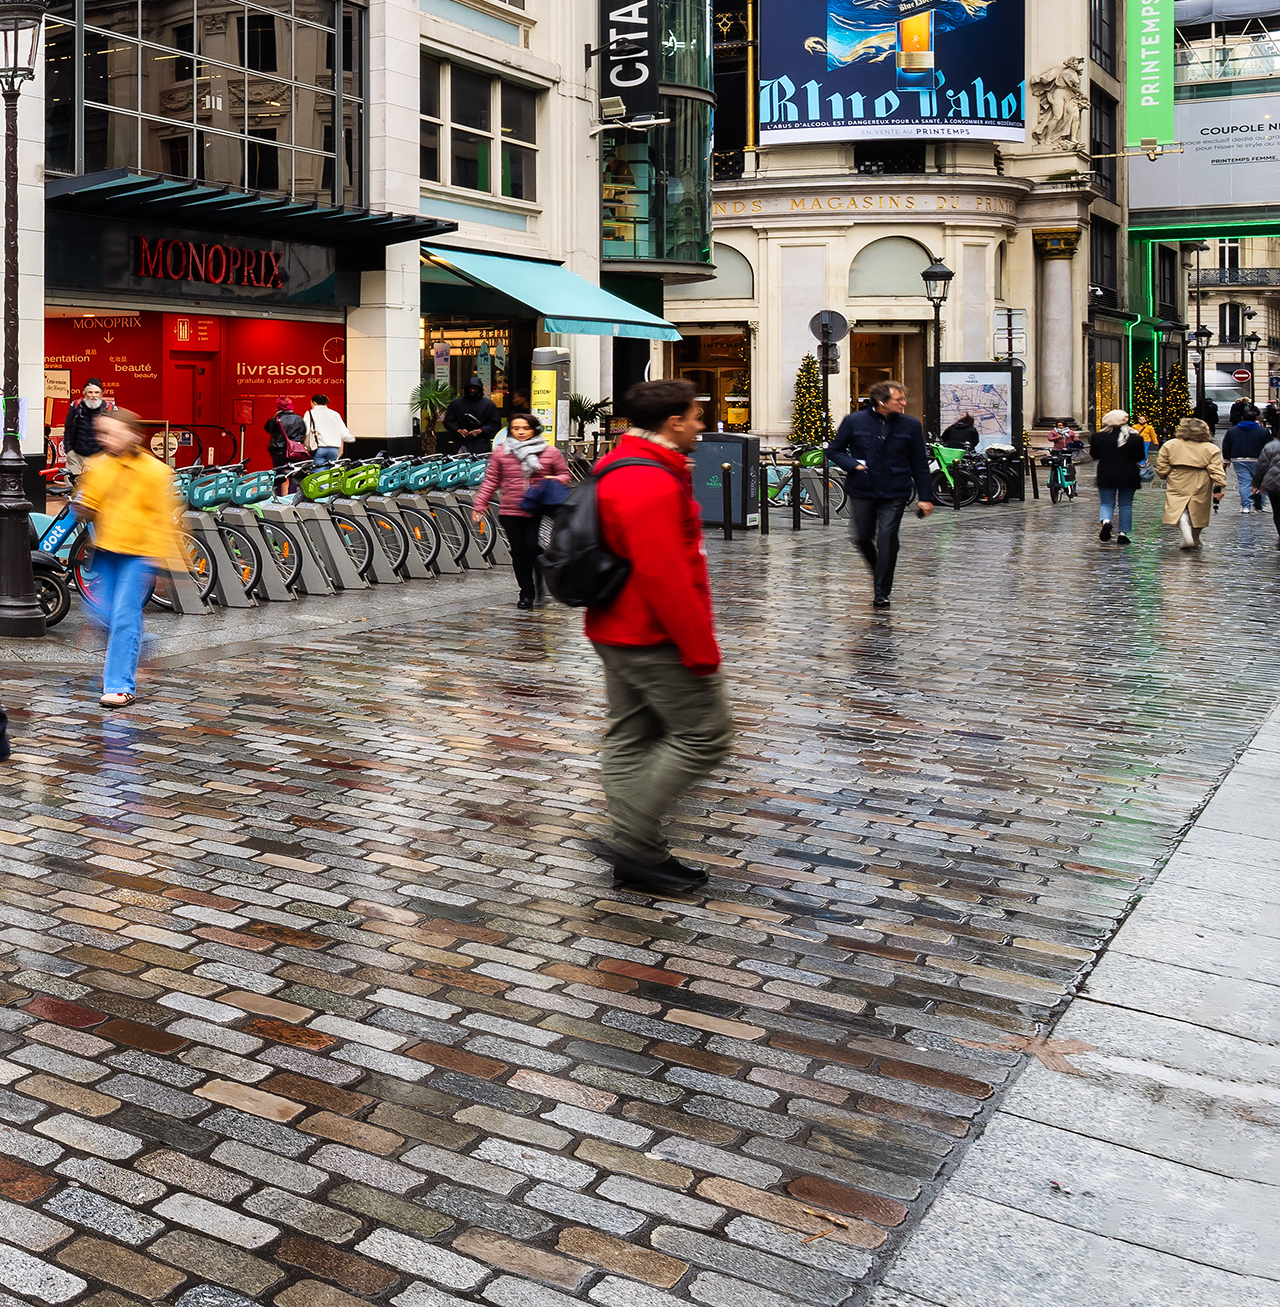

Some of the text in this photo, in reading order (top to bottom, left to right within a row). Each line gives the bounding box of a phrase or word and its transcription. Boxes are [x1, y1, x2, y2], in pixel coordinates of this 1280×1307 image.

[916, 128, 970, 136] PRINTEMPS
[1200, 123, 1265, 136] COUPOLE
[1231, 135, 1253, 143] dédié
[1245, 141, 1263, 149] style
[789, 196, 916, 211] MAGASINS
[936, 195, 960, 210] DU
[137, 236, 285, 289] MONOPRIX
[73, 316, 142, 329] MONOPRIX
[114, 363, 152, 372] beauté
[236, 362, 322, 376] livraison
[43, 525, 66, 552] dott
